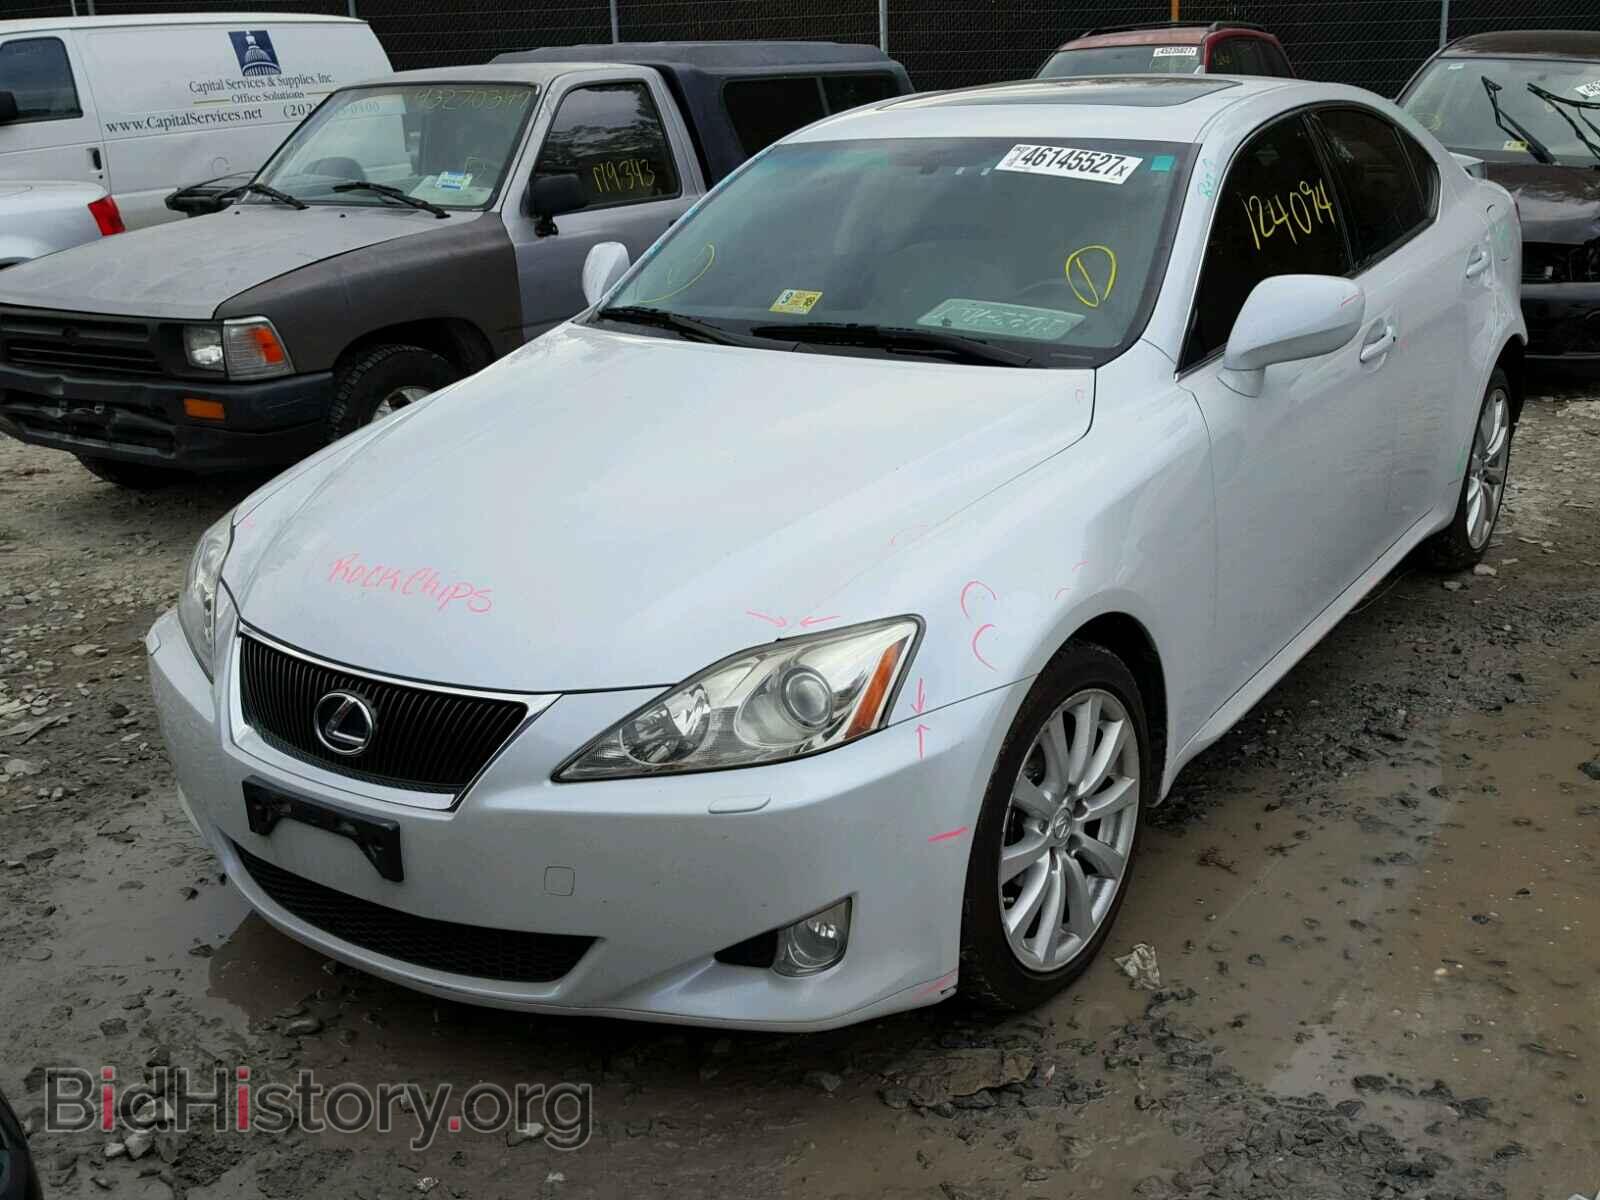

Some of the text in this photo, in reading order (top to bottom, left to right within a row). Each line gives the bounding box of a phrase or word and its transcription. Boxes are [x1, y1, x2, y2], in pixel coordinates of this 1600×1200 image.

[189, 79, 225, 96] Capital
[225, 77, 266, 91] Services
[267, 77, 276, 88] &
[231, 90, 305, 104] Office Solutions
[106, 107, 264, 134] www.CapitalServices.net
[1021, 146, 1126, 175] 46145527
[1241, 178, 1336, 250] 124094
